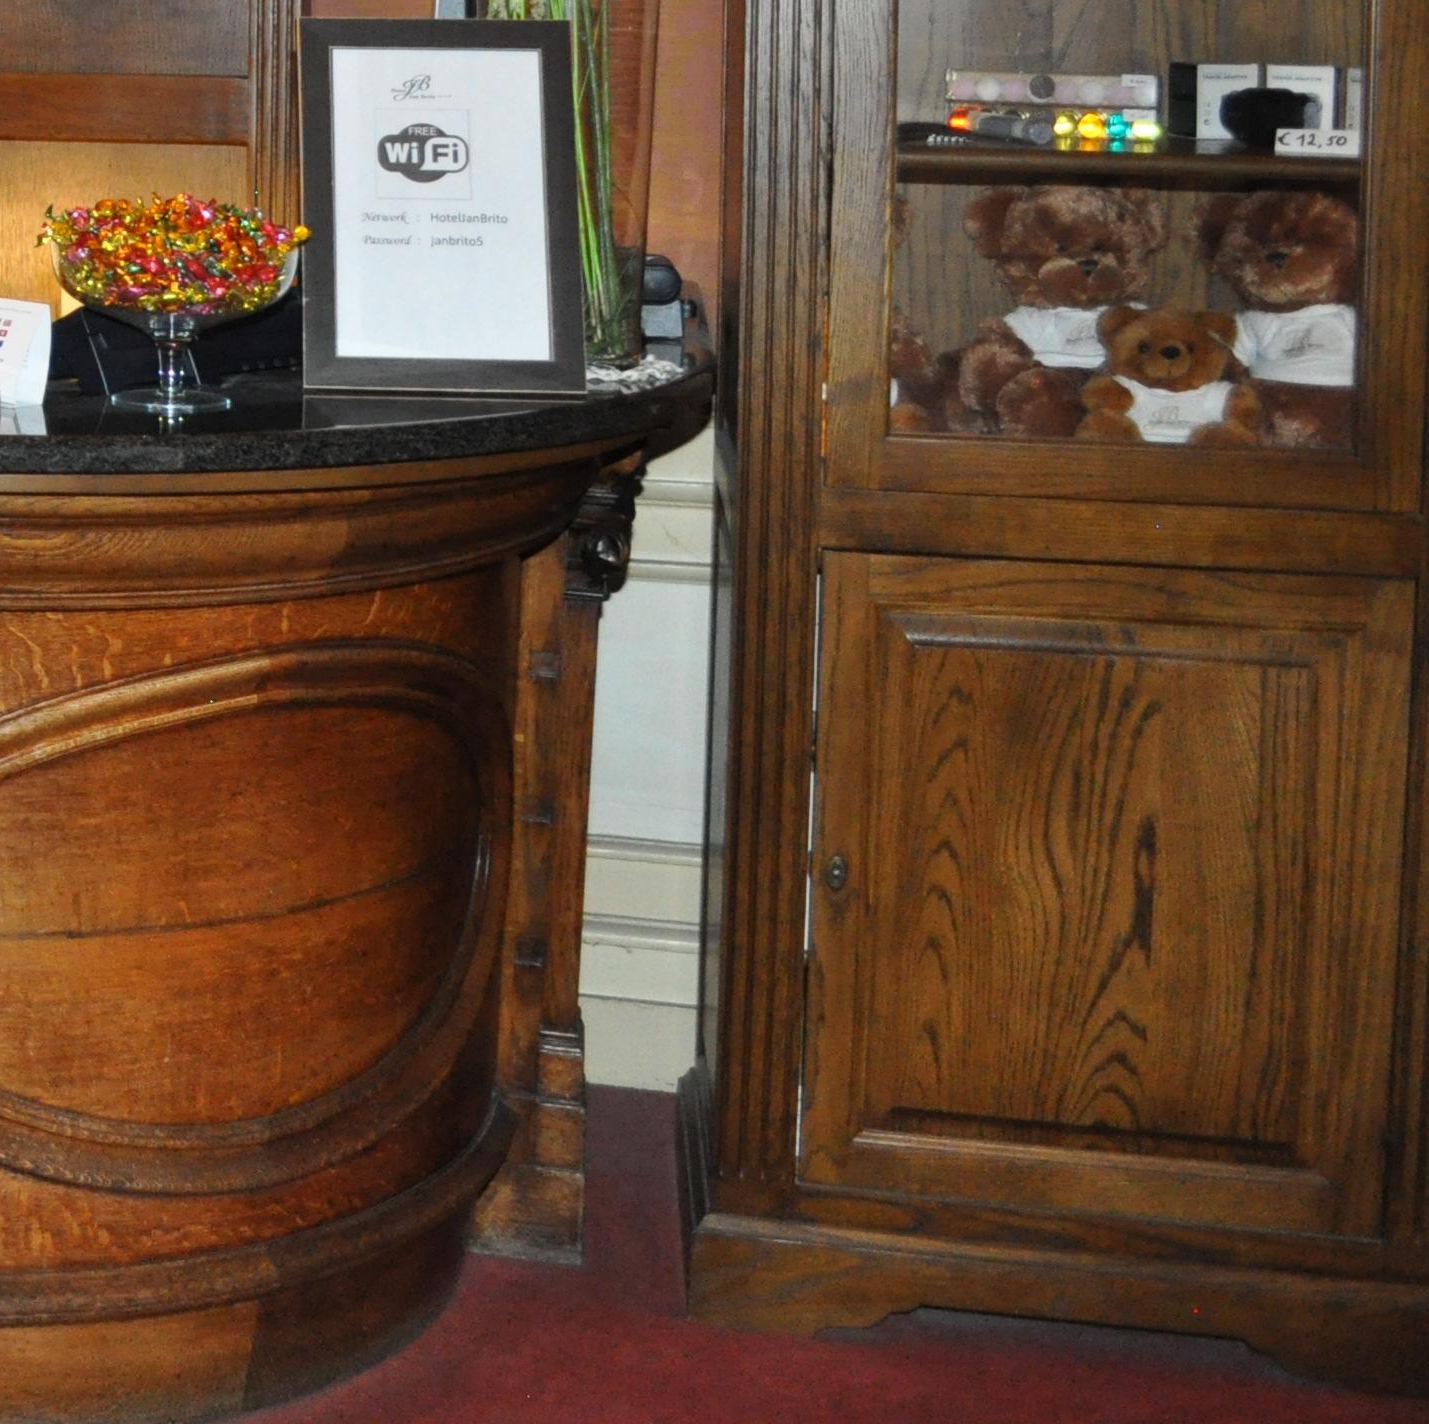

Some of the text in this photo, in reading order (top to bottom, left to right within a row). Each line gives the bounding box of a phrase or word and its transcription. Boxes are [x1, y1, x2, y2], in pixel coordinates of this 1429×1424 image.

[407, 127, 438, 137] FREE
[1278, 132, 1347, 149] € 12,50
[362, 211, 410, 225] Network
[430, 212, 509, 225] HotelJanBrito
[363, 235, 413, 246] Password
[430, 235, 484, 248] janbrito5
